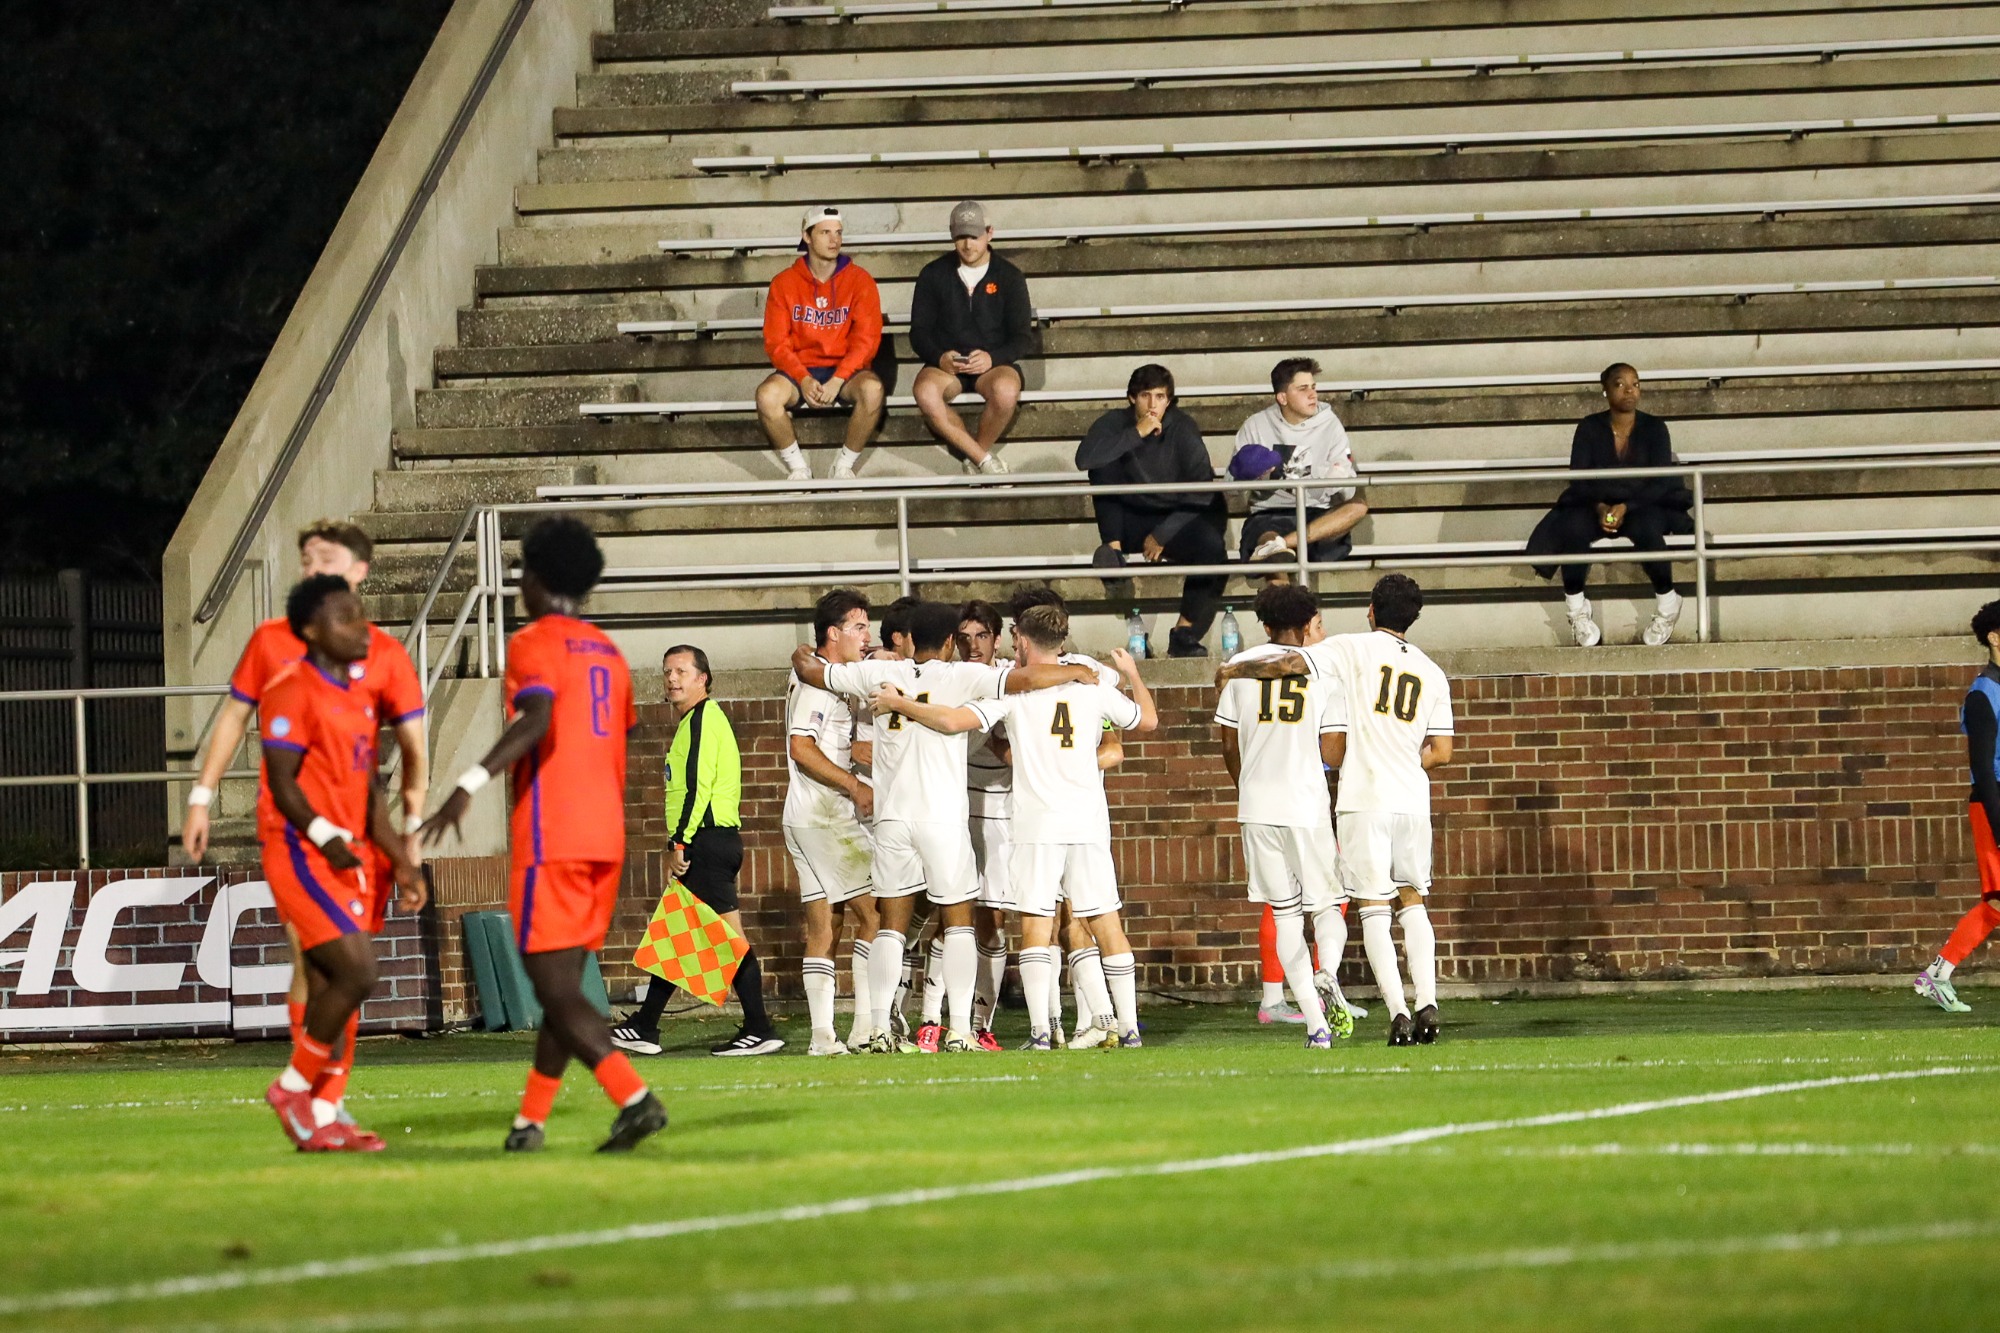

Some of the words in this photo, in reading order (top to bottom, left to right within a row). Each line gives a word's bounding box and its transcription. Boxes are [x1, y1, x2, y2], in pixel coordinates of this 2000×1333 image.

[793, 304, 850, 326] CEMSON
[589, 664, 611, 737] 8
[1257, 674, 1308, 724] 15
[1374, 664, 1423, 724] 10
[1050, 701, 1075, 749] 4
